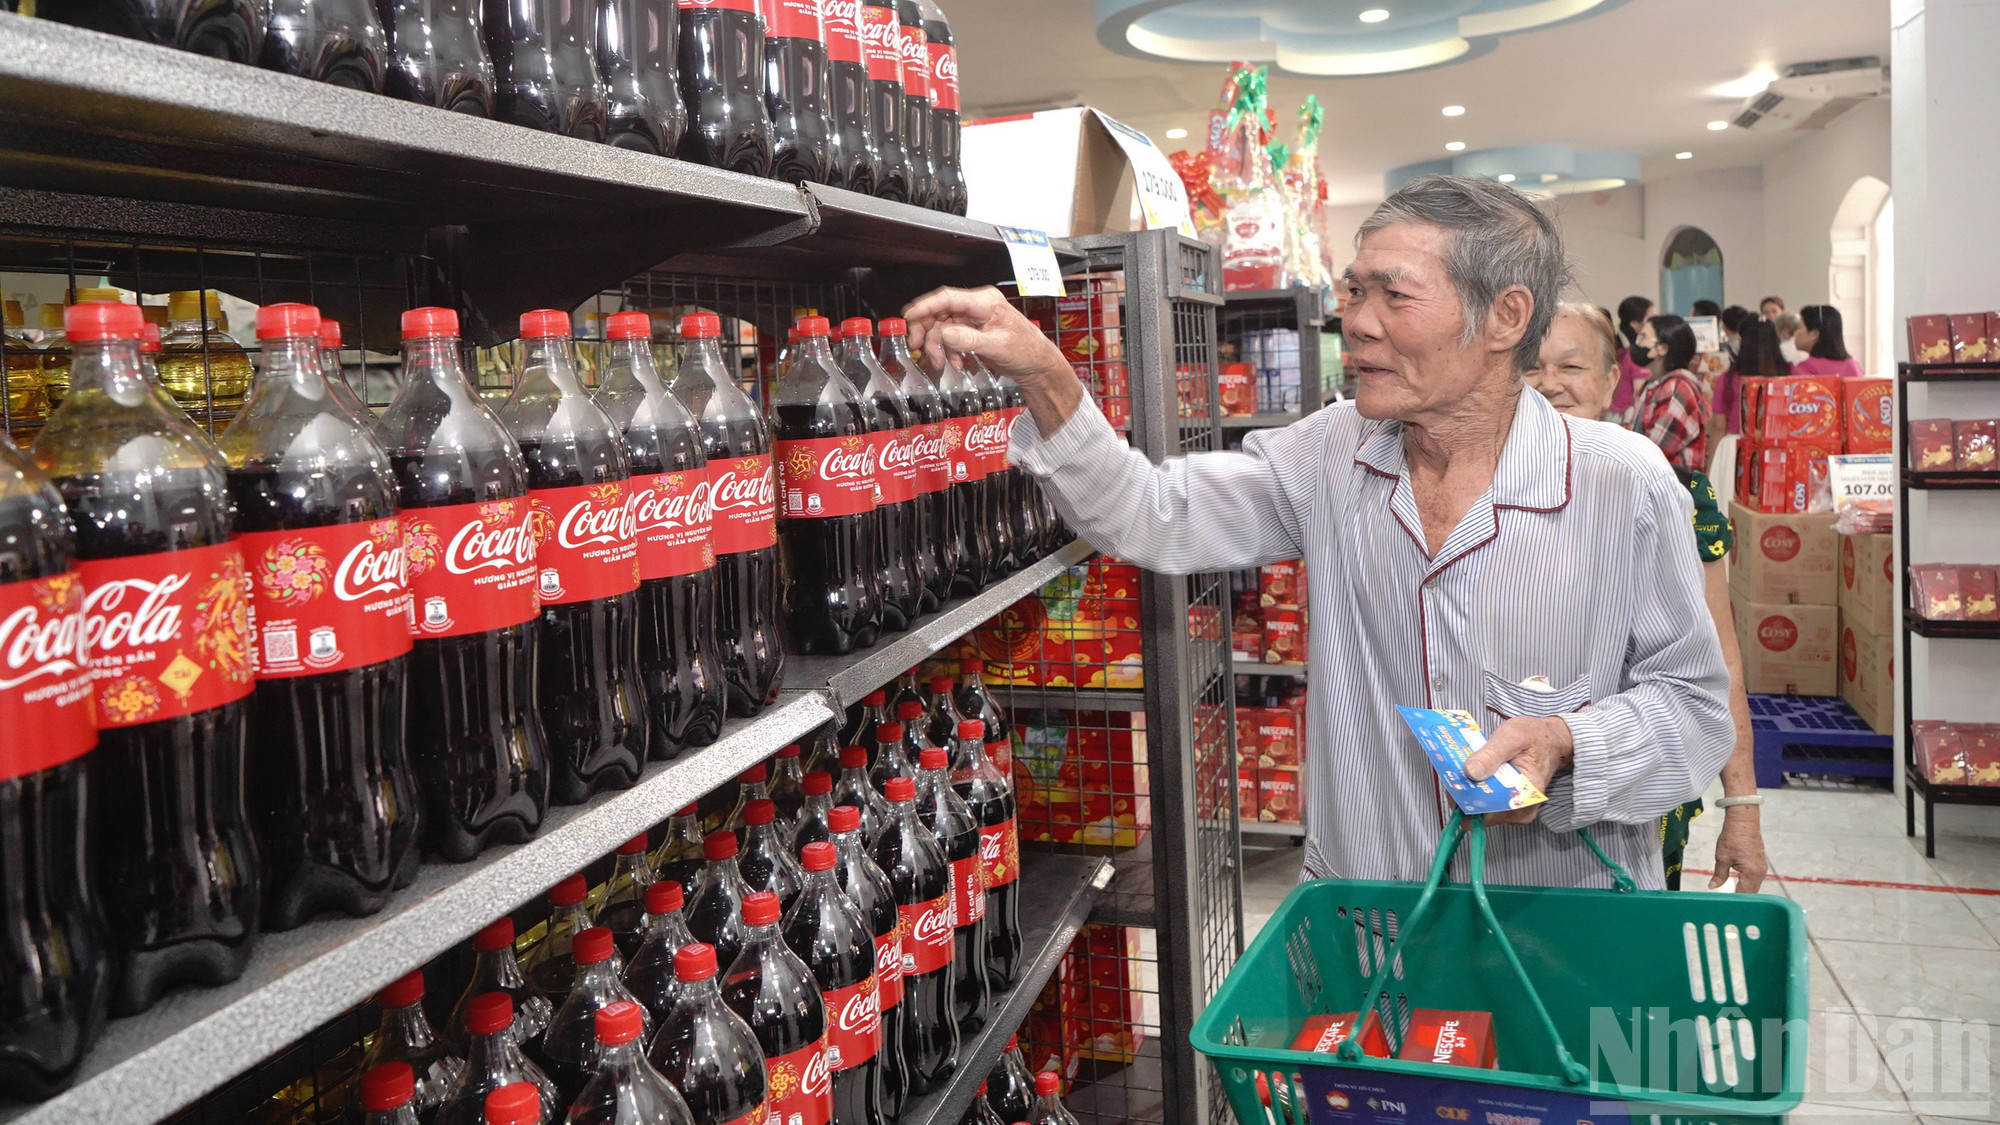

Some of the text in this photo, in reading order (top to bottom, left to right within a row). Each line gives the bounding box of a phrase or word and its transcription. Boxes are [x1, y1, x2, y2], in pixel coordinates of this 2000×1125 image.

[1788, 402, 1821, 415] COSY
[1792, 481, 1806, 511] COSY
[647, 533, 675, 543] HƯƠNG
[667, 538, 686, 547] GIẢM
[1763, 538, 1796, 549] COSY
[583, 548, 610, 558] HƯƠNG
[603, 553, 621, 563] GIẢM
[474, 573, 506, 586] HƯƠNG
[497, 578, 518, 590] GIẢM
[1760, 627, 1794, 638] COSY
[1314, 1020, 1345, 1053] ESCAFE
